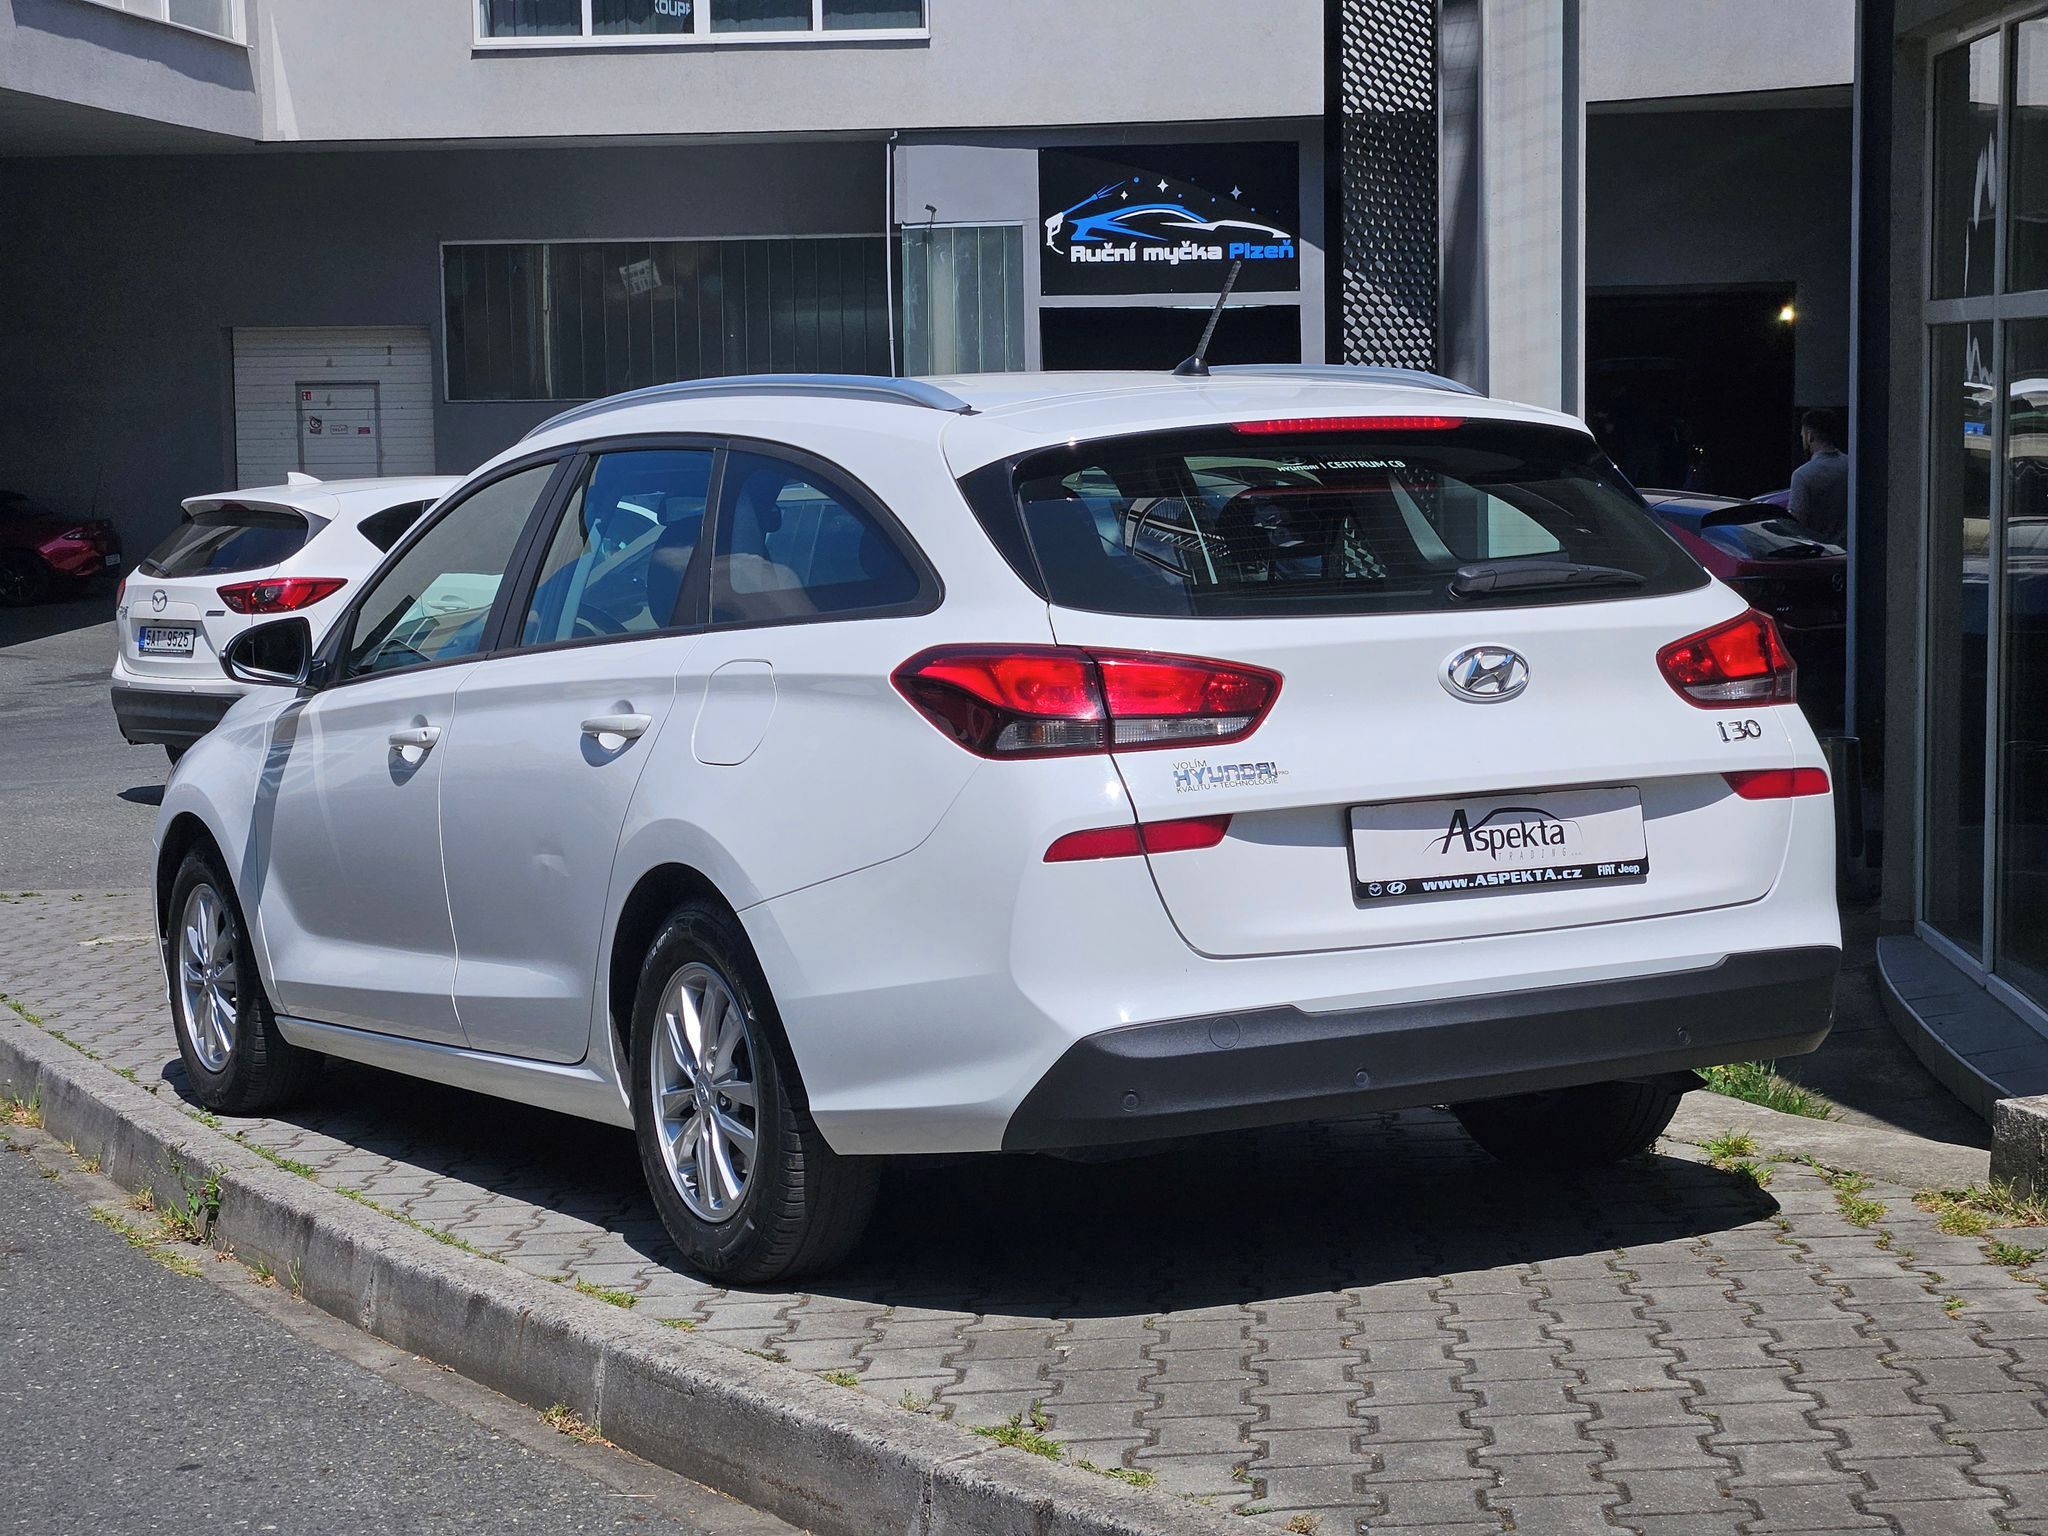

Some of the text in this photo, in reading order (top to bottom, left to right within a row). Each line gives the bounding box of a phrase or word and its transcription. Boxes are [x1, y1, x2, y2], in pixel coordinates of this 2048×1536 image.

[1070, 239, 1295, 265] Ruční myčka Plzeň
[1277, 464, 1320, 472] HYUNDAI
[1327, 460, 1388, 469] CENTRUM
[167, 631, 190, 648] 9525
[1716, 720, 1761, 742] i30
[1173, 758, 1208, 770] VOLÍM
[1173, 761, 1278, 787] HYUNDAI
[1176, 783, 1211, 794] KVALITU
[1220, 778, 1278, 789] TECHNOLOGIE
[1441, 808, 1566, 861] Aspekta
[1422, 863, 1640, 892] www.ASPEKTA.cz FIAT Jeep
